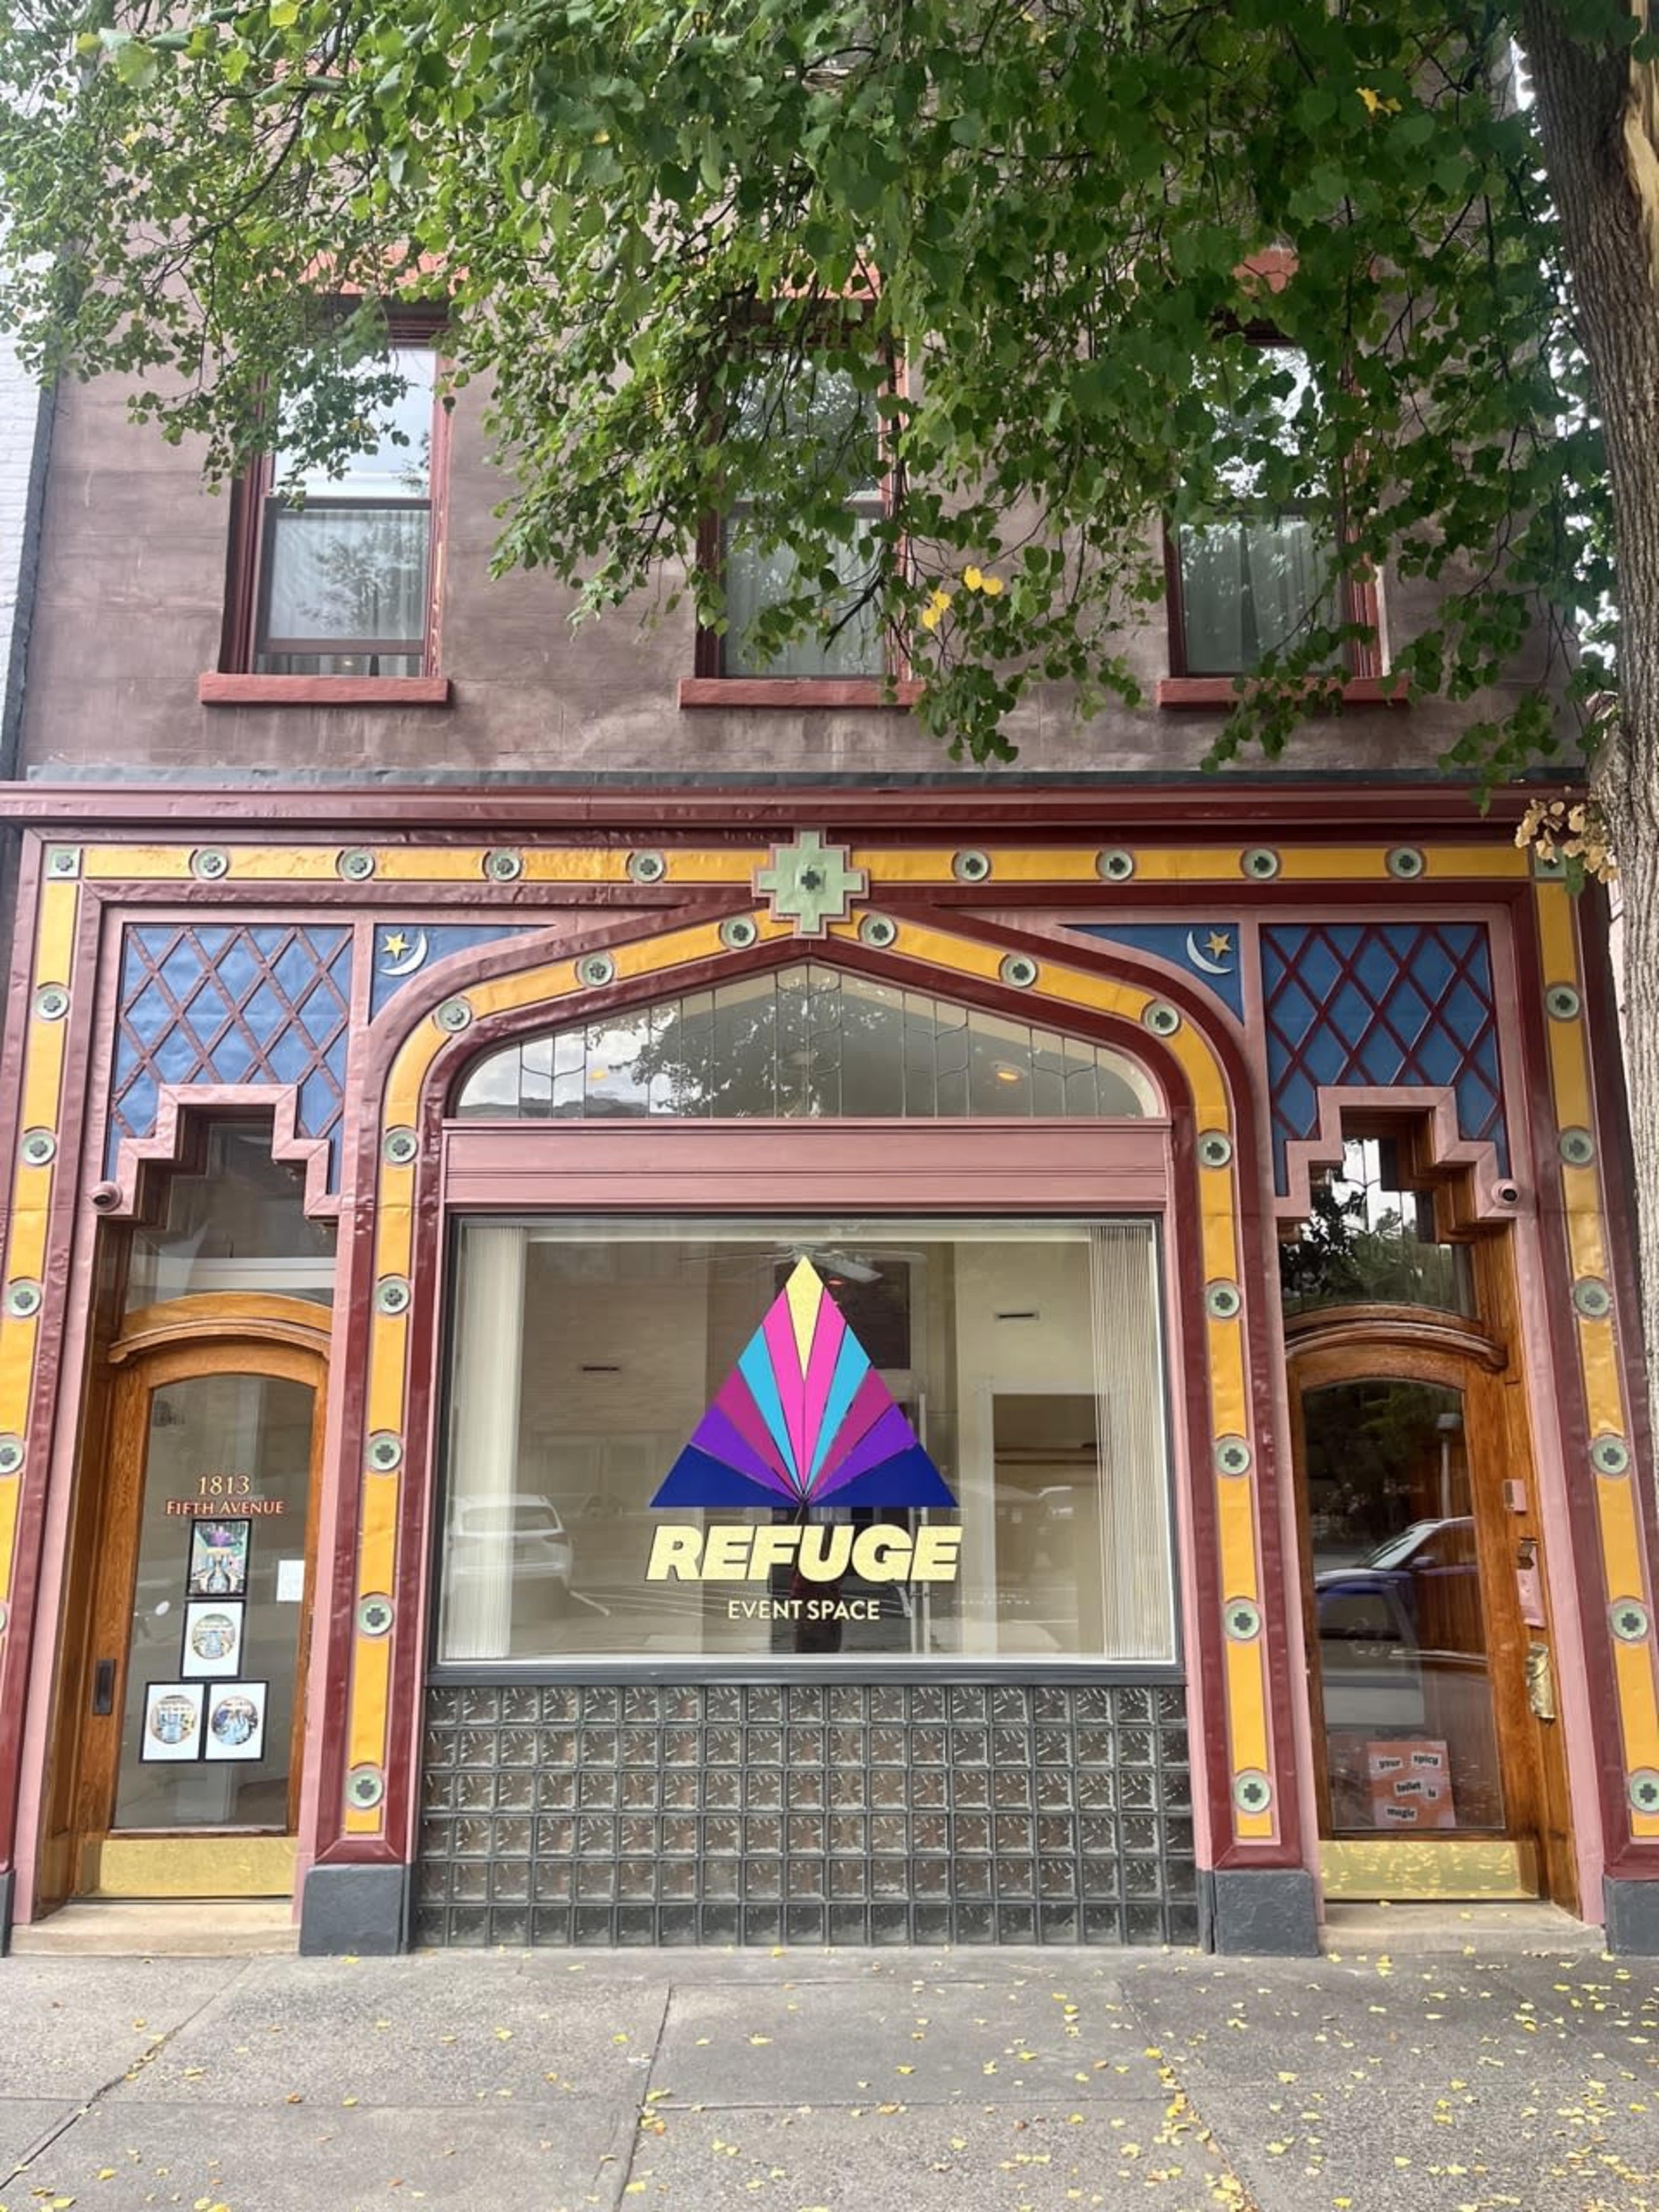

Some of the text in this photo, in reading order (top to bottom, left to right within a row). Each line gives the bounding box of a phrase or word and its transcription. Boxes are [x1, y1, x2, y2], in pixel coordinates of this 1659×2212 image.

[198, 1475, 250, 1495] 1813
[165, 1500, 285, 1515] FIFTH AVENUE
[645, 1523, 963, 1582] REFUGE
[728, 1599, 880, 1621] EVENT SPACE
[1413, 1755, 1439, 1766] spicy
